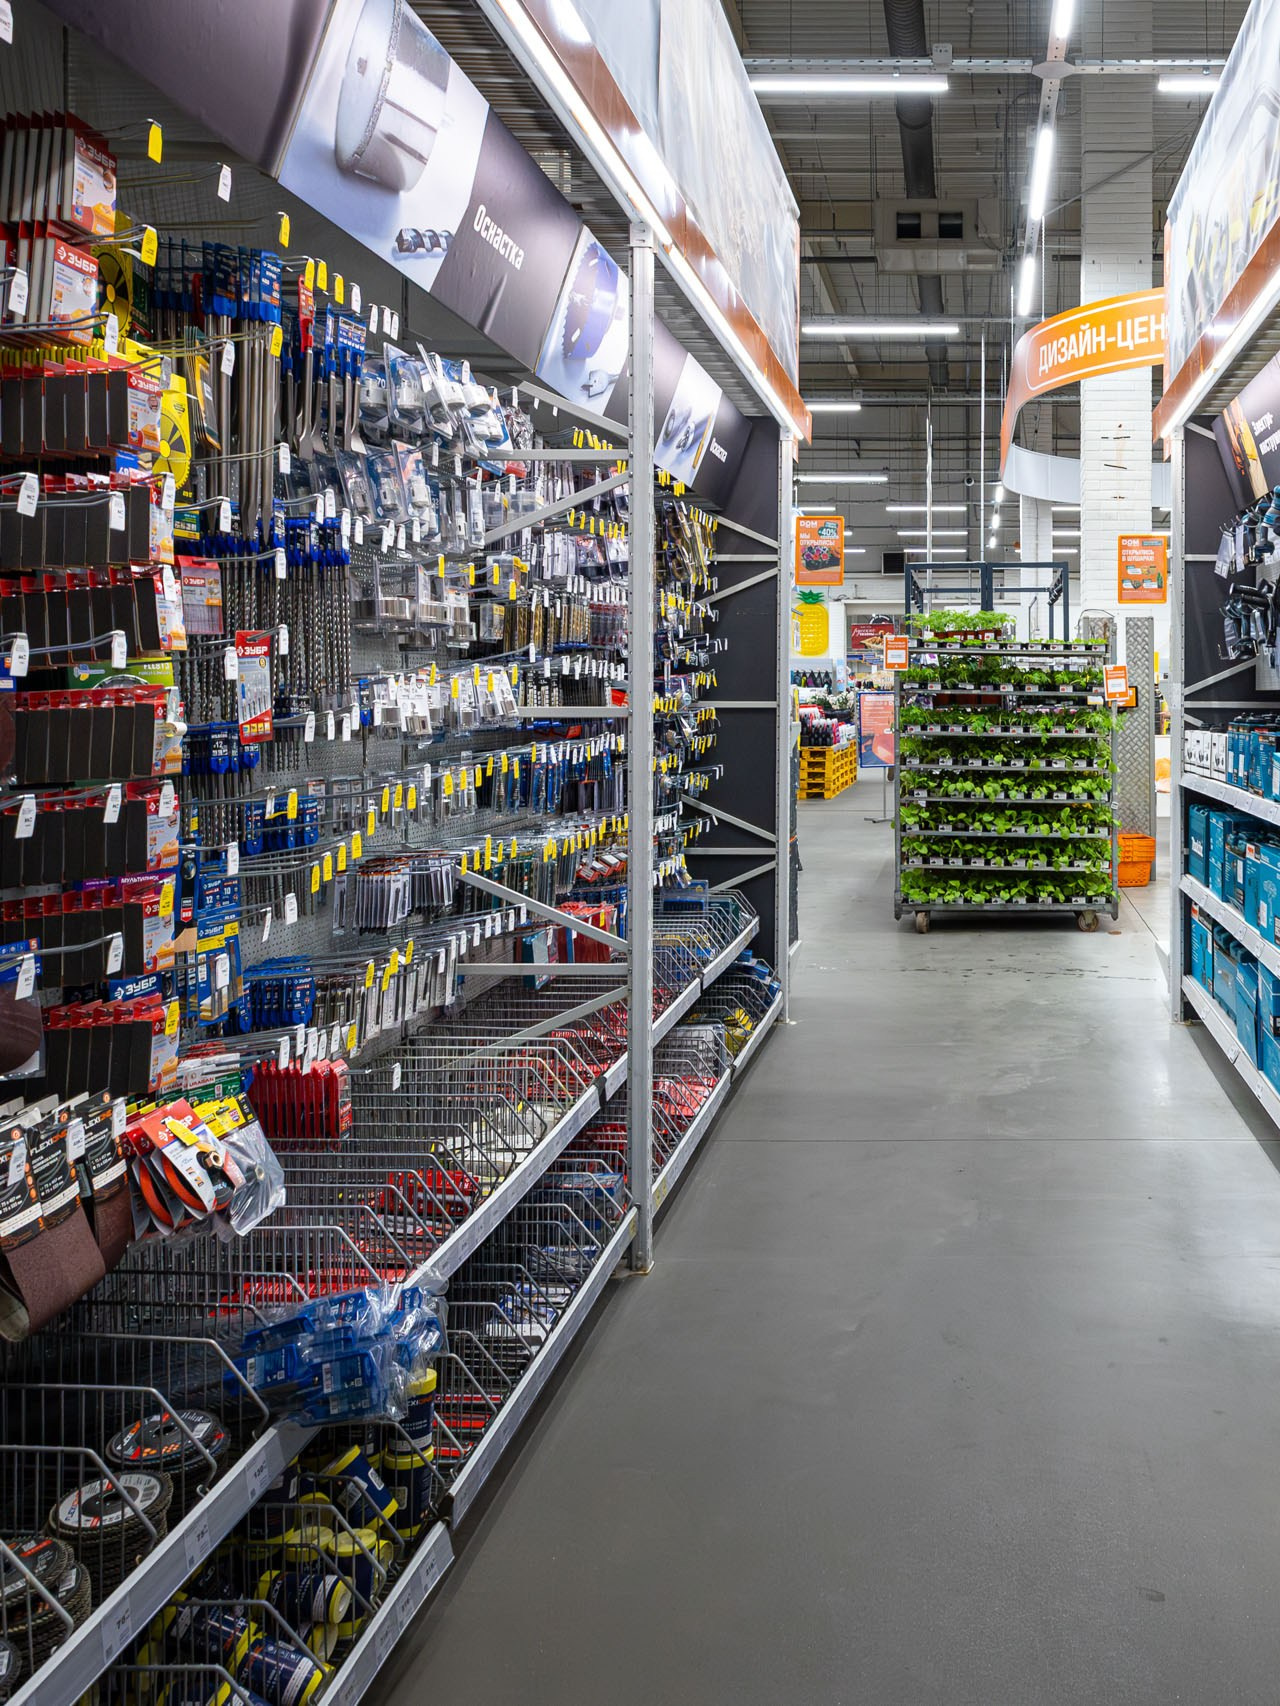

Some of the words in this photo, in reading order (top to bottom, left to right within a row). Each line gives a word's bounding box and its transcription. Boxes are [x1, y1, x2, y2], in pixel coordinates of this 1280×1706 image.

[88, 145, 117, 169] ЗУБР
[473, 204, 525, 270] Оснастка
[67, 252, 97, 273] ЗУБР
[1251, 412, 1273, 436] Электро-
[244, 646, 268, 656] ЗУБР
[204, 925, 223, 935] ЗУБР
[125, 976, 157, 995] ЗУБР
